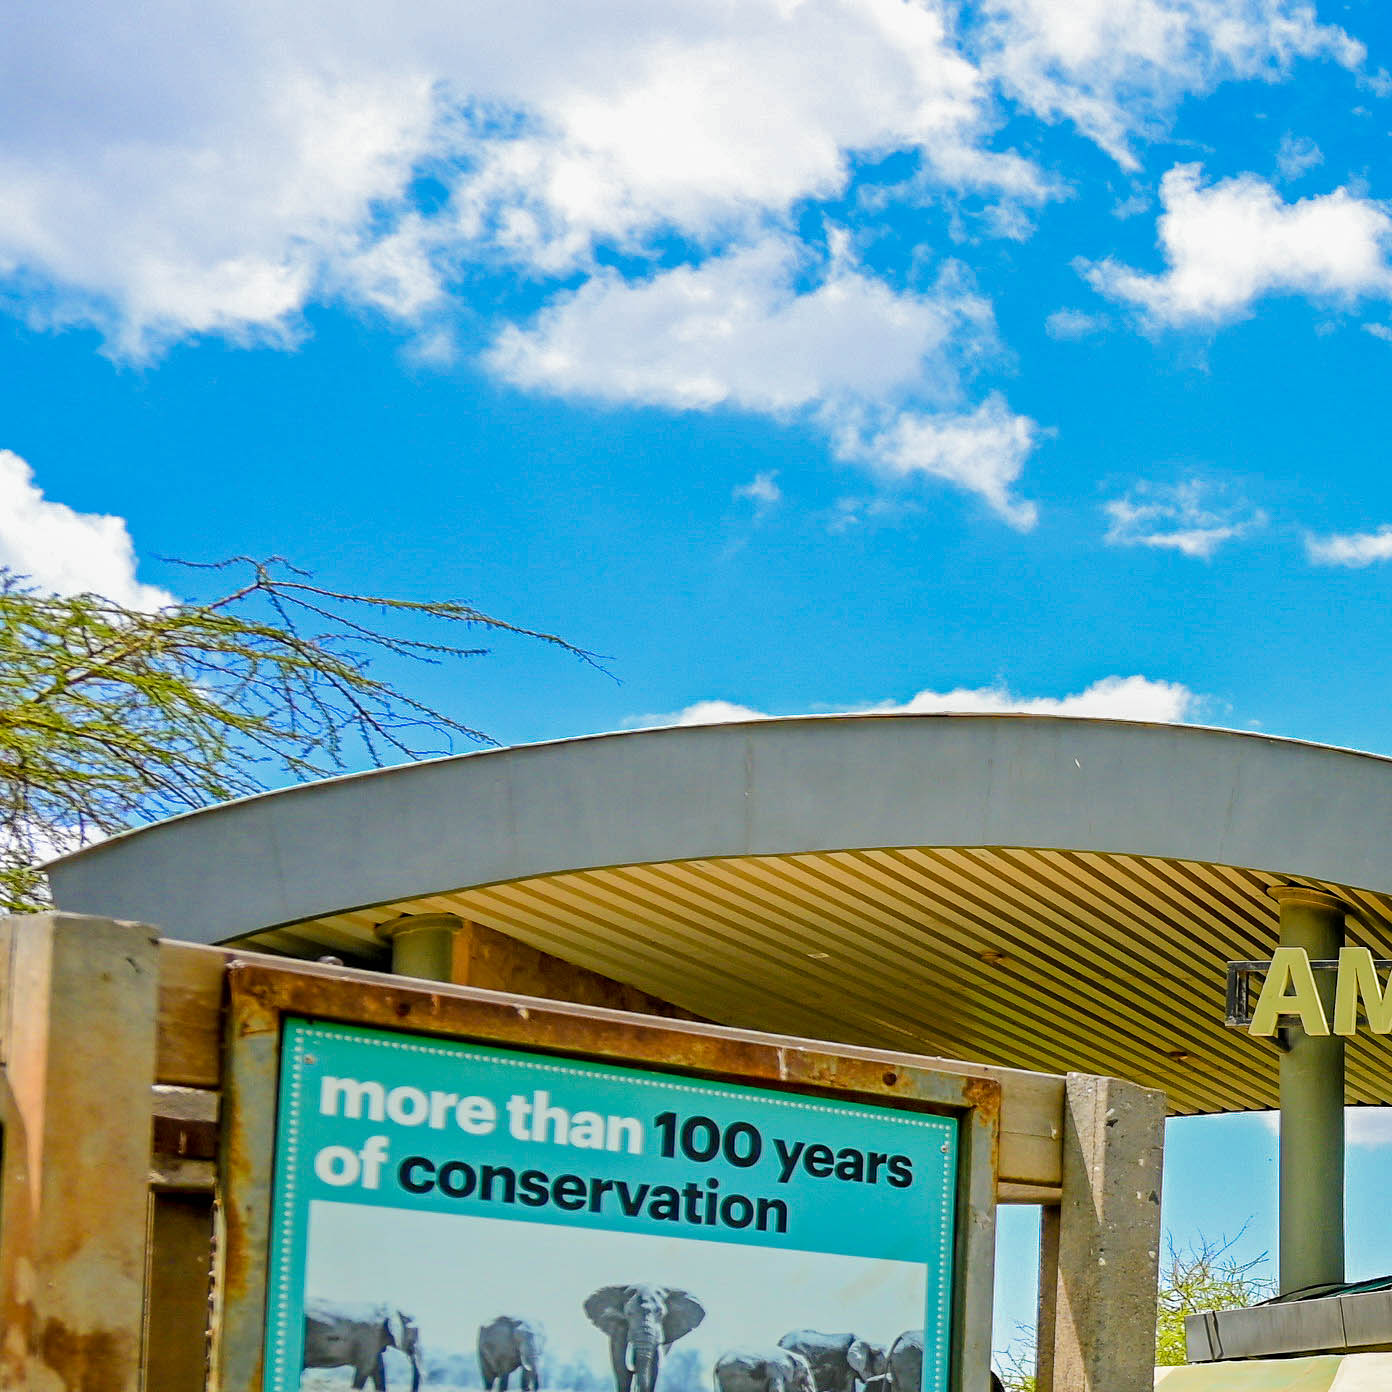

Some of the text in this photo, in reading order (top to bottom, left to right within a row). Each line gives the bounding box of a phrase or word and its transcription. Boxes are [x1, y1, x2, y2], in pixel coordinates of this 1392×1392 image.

[314, 1135, 790, 1233] of conservation
[319, 1075, 914, 1190] more than 100 years
